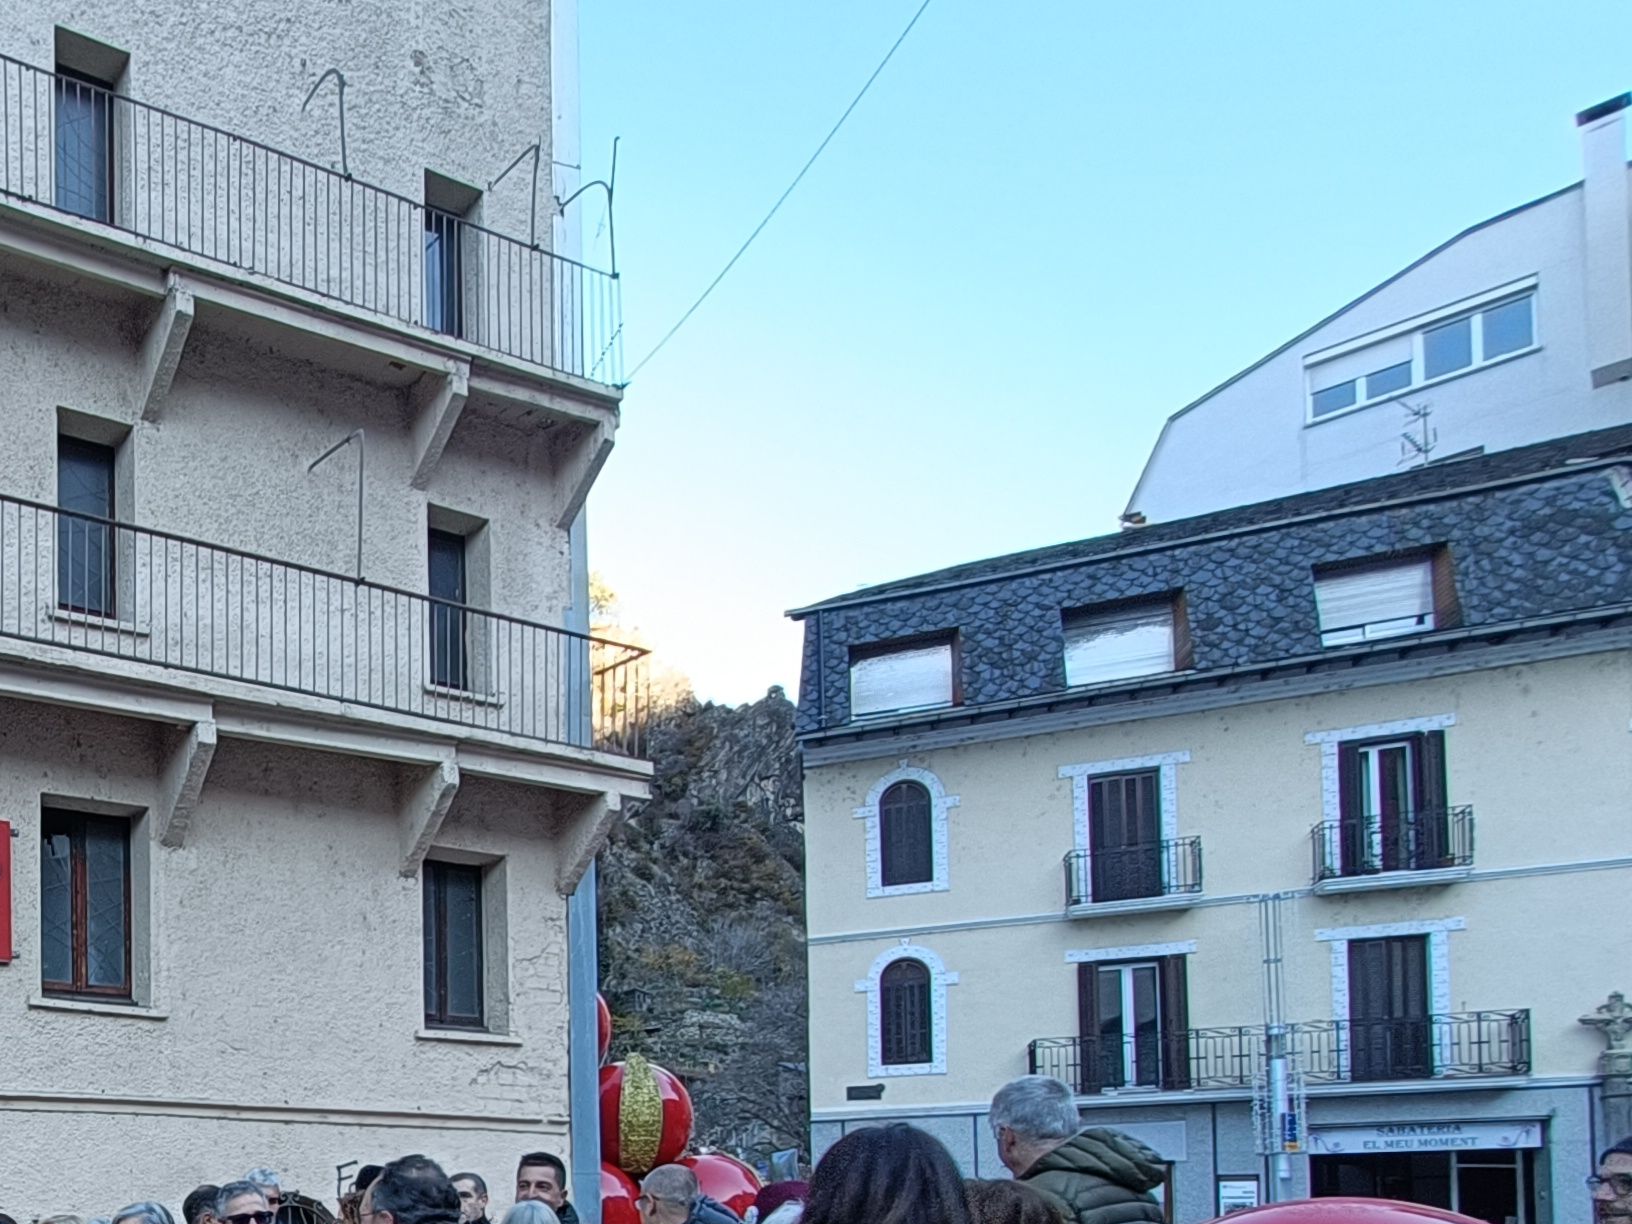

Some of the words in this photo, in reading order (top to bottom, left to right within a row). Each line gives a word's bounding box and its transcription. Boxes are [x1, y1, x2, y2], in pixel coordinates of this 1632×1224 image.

[1376, 1124, 1463, 1137] SABATERIA
[1363, 1140, 1380, 1150] EL
[1383, 1139, 1414, 1149] MEU
[1418, 1137, 1479, 1148] MOMENT
